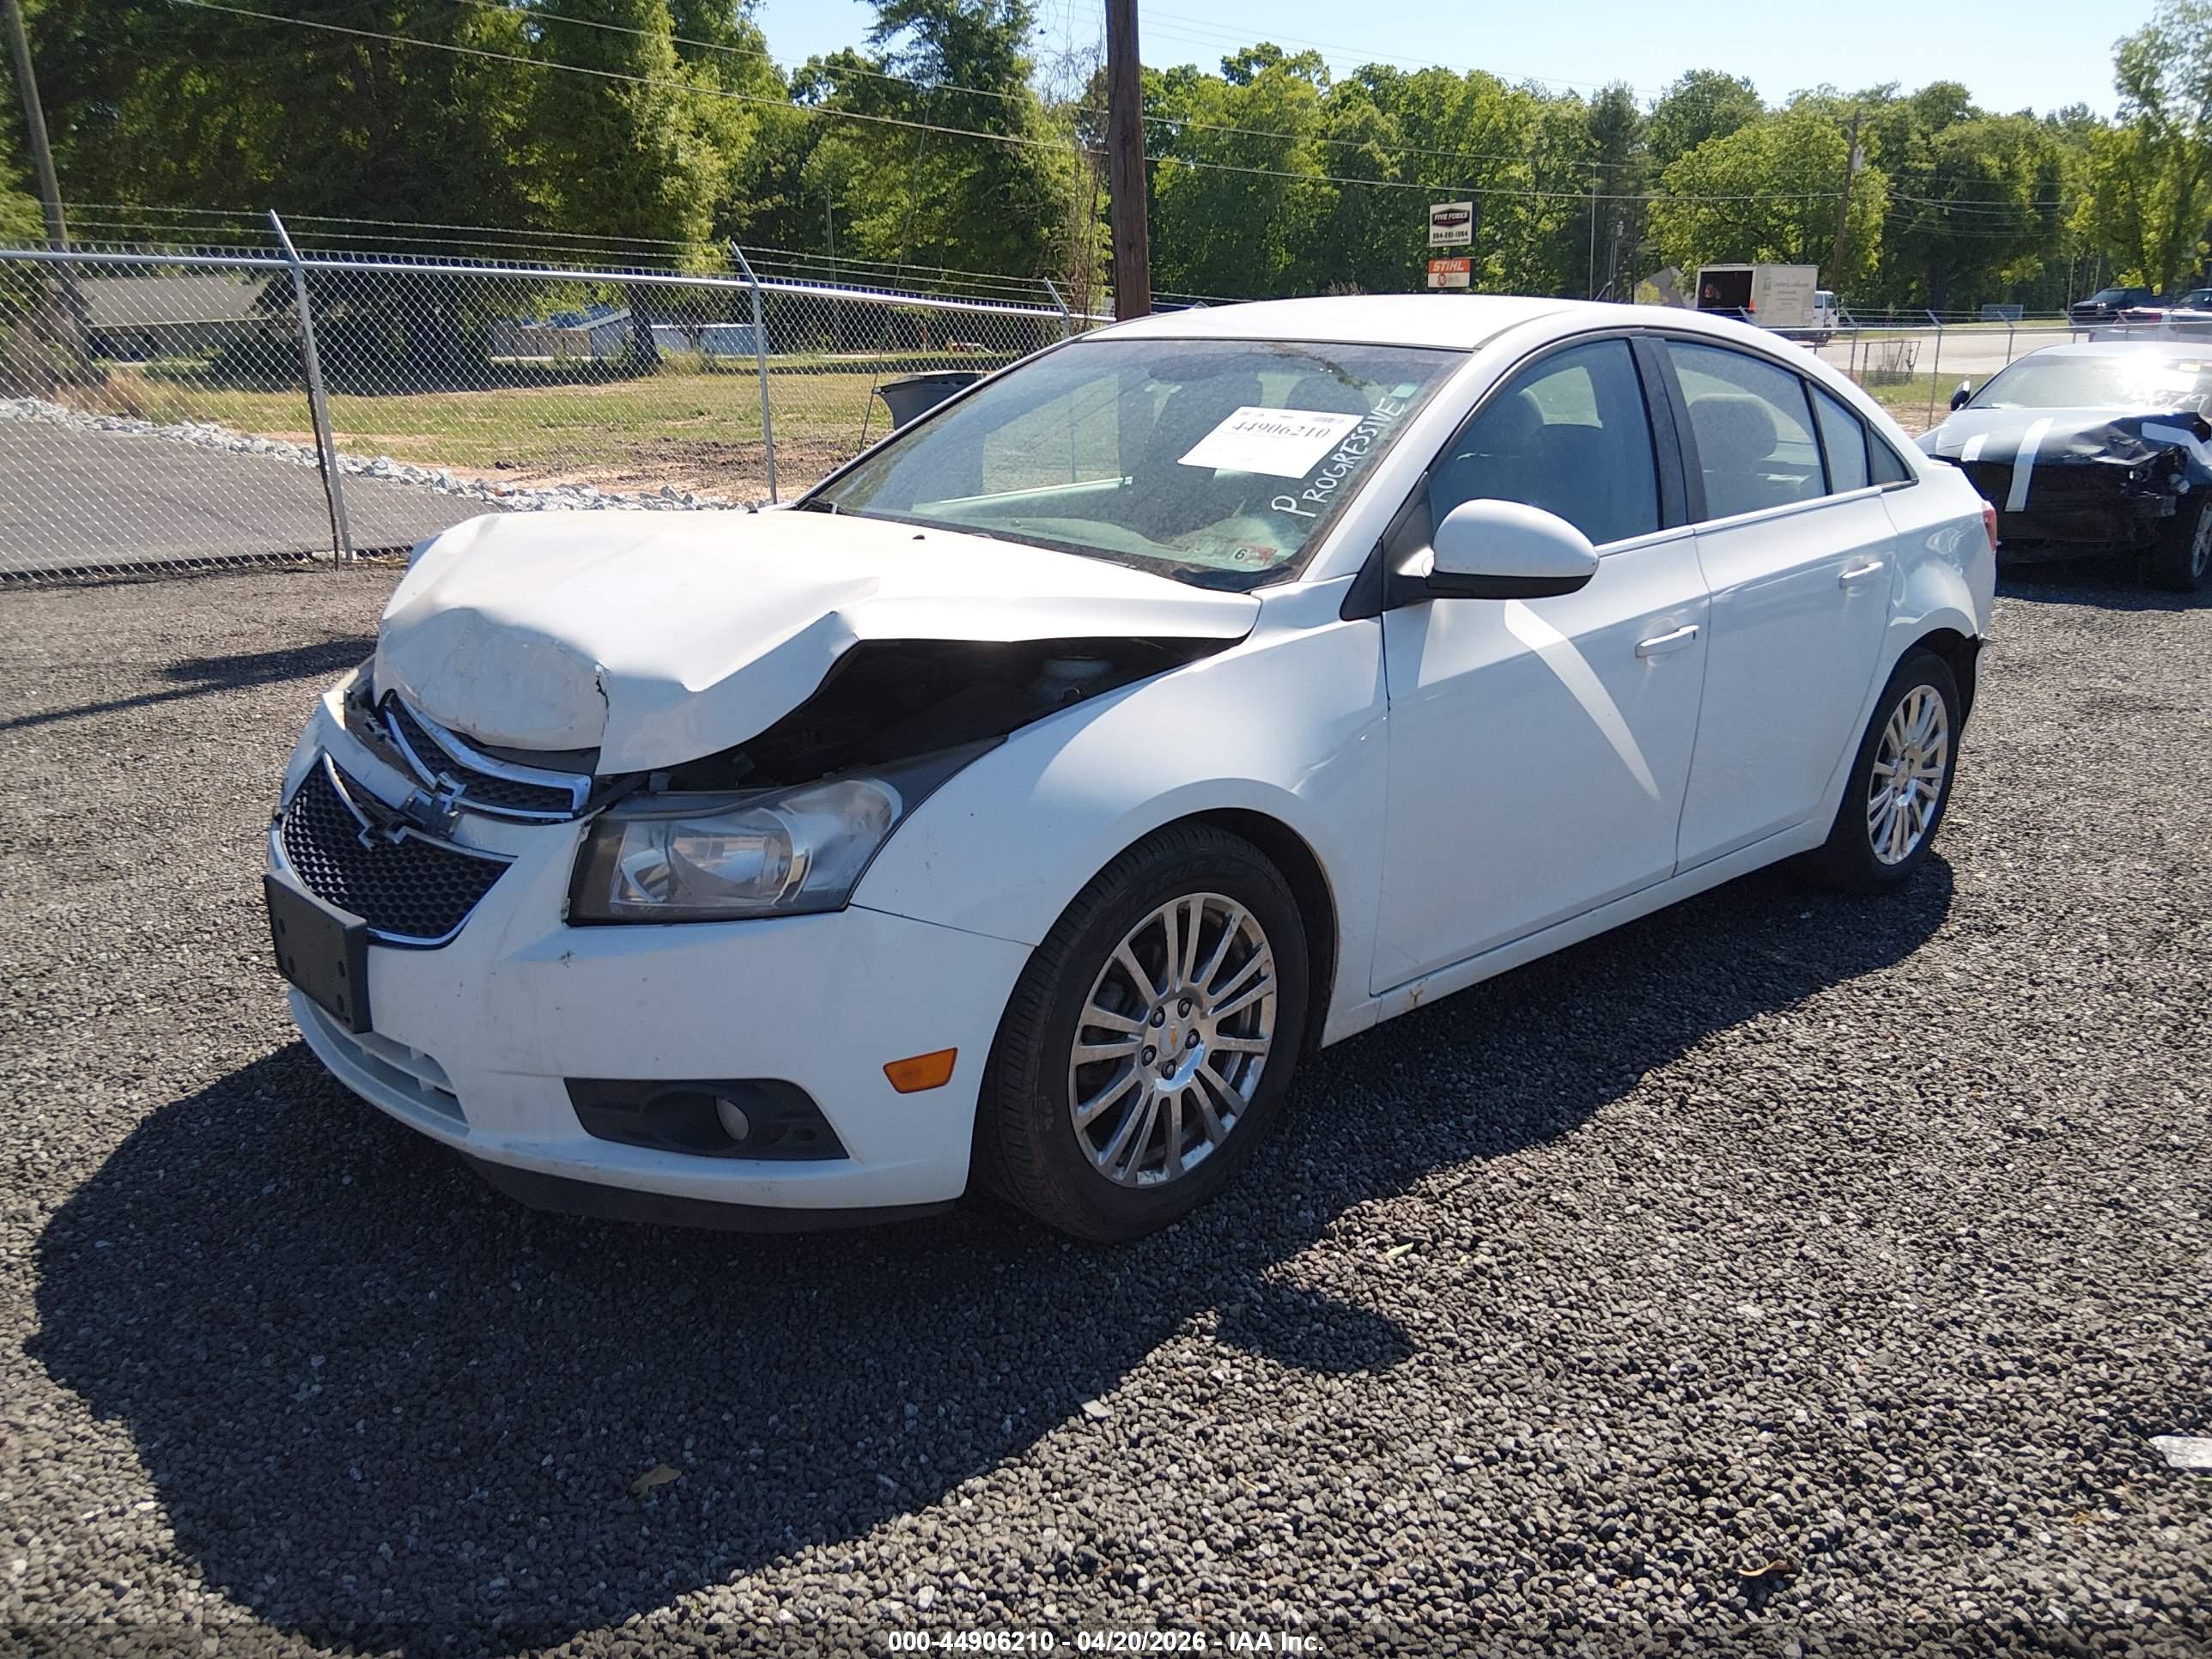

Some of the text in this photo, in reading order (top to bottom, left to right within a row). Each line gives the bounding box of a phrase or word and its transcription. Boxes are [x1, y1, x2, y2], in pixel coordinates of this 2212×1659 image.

[1432, 261, 1464, 271] STIHL
[1231, 421, 1331, 439] 44906210
[1234, 549, 1248, 560] 6
